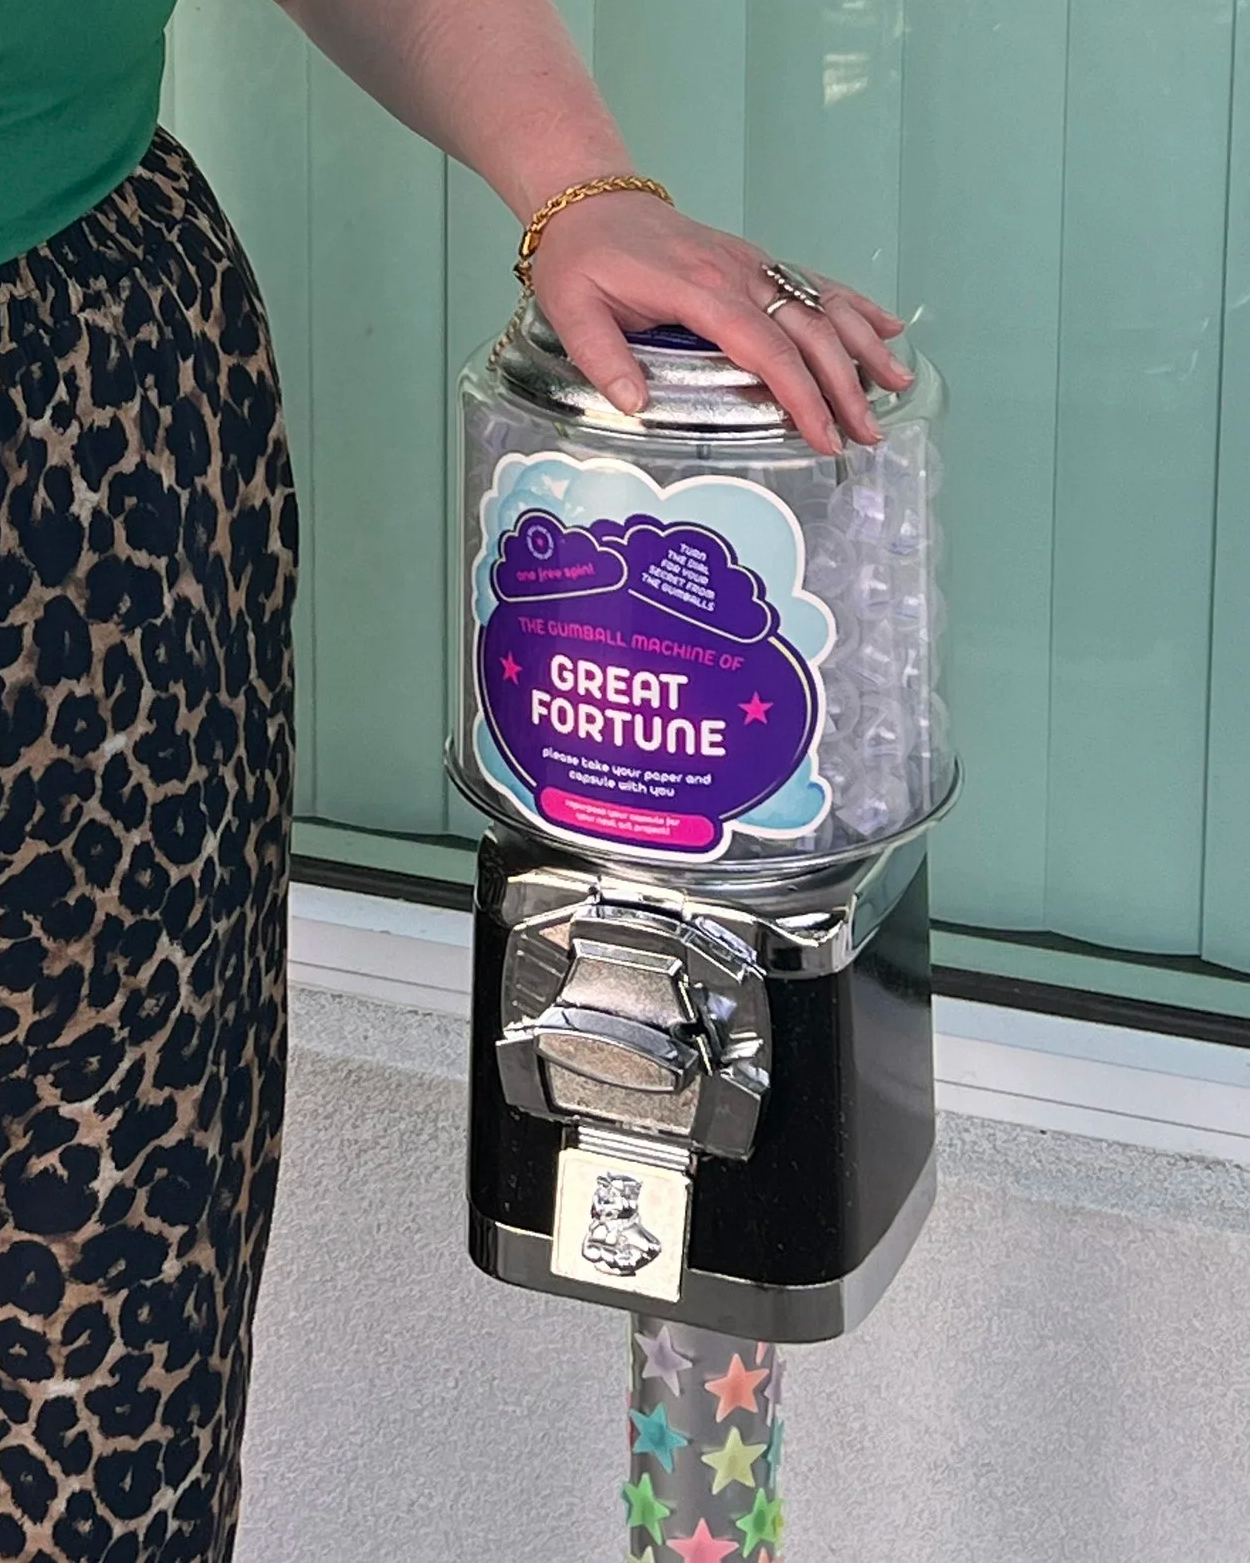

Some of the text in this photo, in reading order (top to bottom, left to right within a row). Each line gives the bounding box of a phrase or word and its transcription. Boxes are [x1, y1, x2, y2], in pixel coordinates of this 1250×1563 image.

[642, 572, 715, 612] THE GUMBALLS
[518, 616, 745, 671] THE GUMBALL MACHINE OF
[550, 654, 688, 710] GREAT
[531, 689, 726, 756] FORTUNE
[542, 747, 711, 785] please take your paper and
[569, 770, 675, 797] capsule with you
